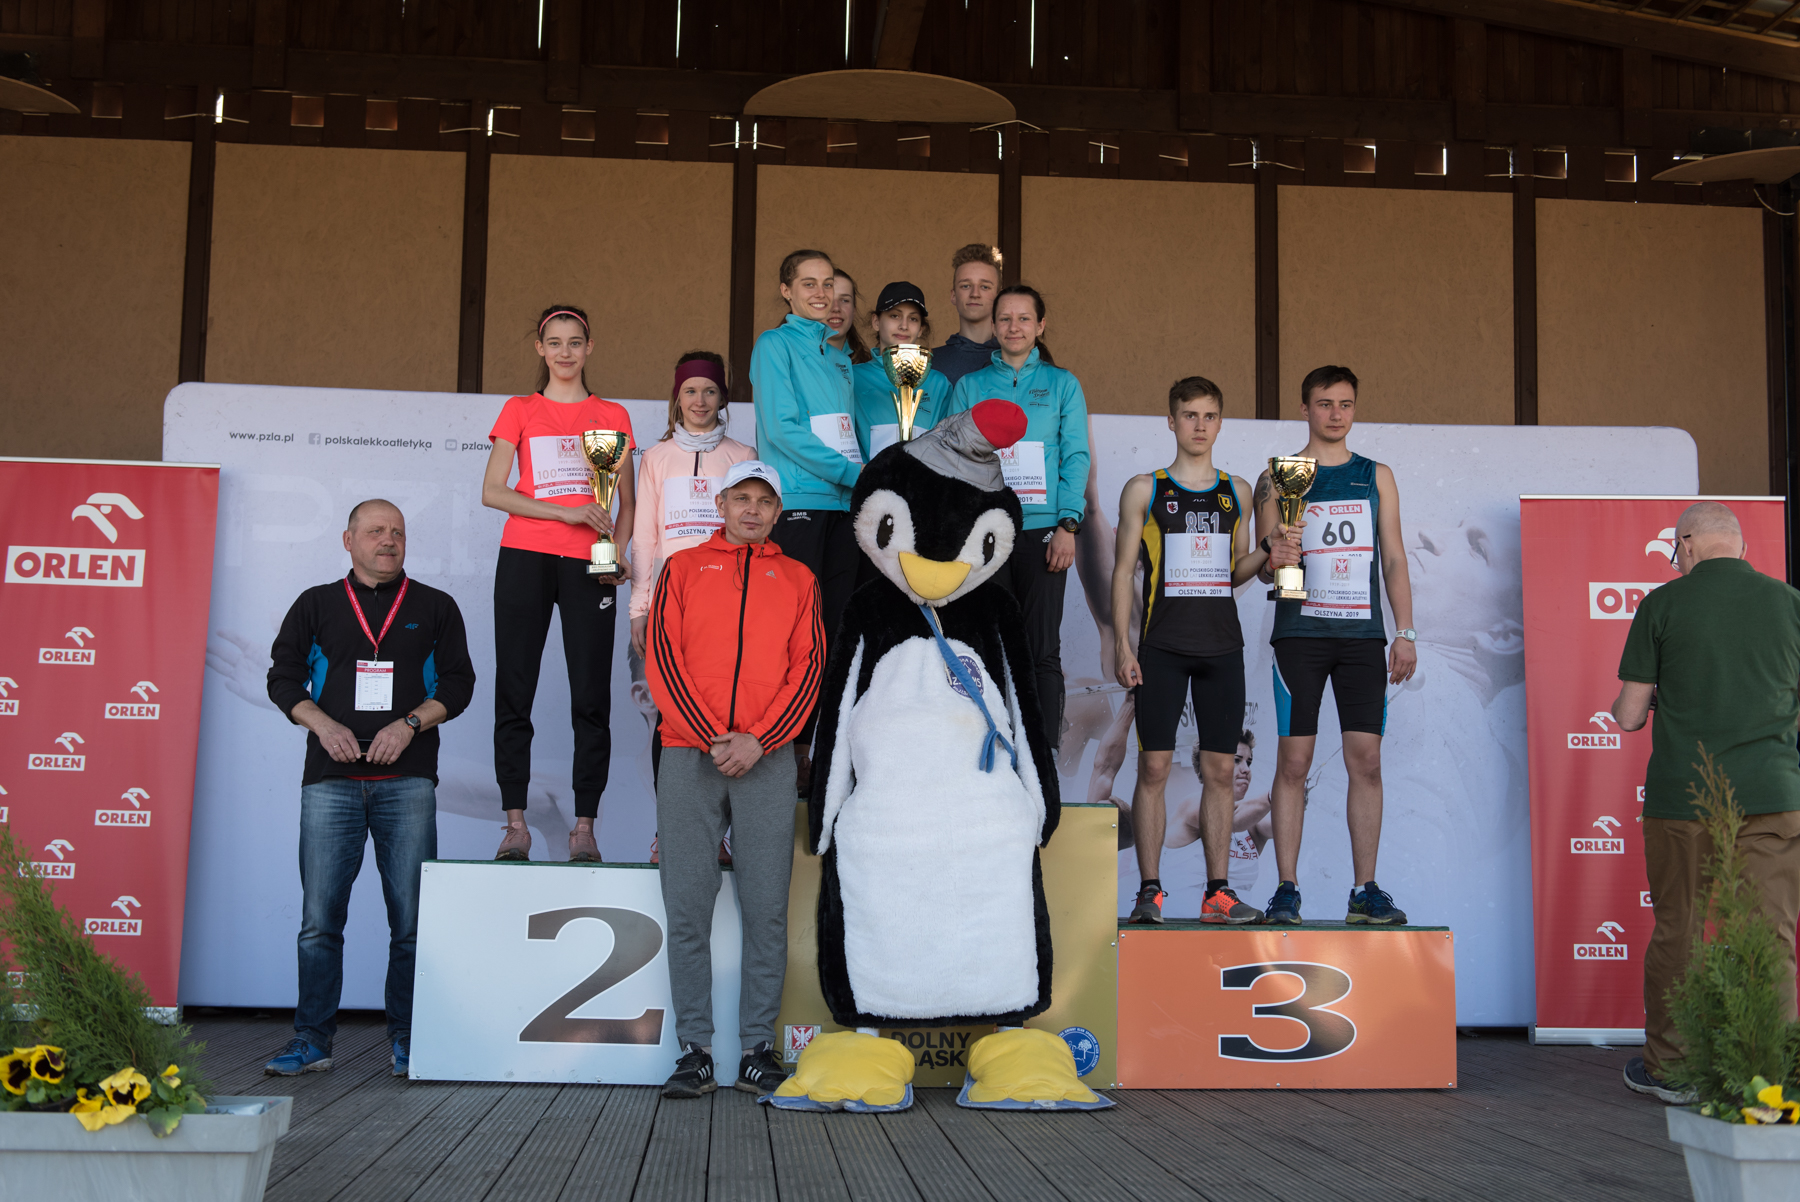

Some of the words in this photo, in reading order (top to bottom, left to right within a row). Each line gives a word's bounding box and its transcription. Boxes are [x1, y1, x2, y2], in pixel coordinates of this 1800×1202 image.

[229, 431, 294, 442] www.pzla.pl
[324, 435, 432, 449] polskalekkoatletyka
[537, 468, 557, 480] 100
[548, 487, 577, 496] OLSZYNA
[669, 509, 688, 521] 100
[1330, 505, 1361, 514] ORLEN
[1185, 511, 1220, 534] 851
[678, 528, 706, 536] OLSZYNA
[1322, 520, 1356, 546] 60
[14, 551, 136, 581] ORLEN
[1169, 568, 1189, 578] 100
[1308, 588, 1326, 600] 100
[42, 650, 92, 663] ORLEN
[108, 706, 156, 717] ORLEN
[1570, 736, 1617, 747] ORLEN
[32, 756, 82, 769] ORLEN
[98, 812, 148, 825] ORLEN
[1573, 840, 1621, 852] ORLEN
[88, 920, 138, 933] ORLEN
[1576, 946, 1624, 958] ORLEN
[518, 905, 666, 1047] 2
[1218, 960, 1357, 1063] 3
[890, 1032, 972, 1049] DOLNY
[914, 1050, 965, 1070] ĄSK
